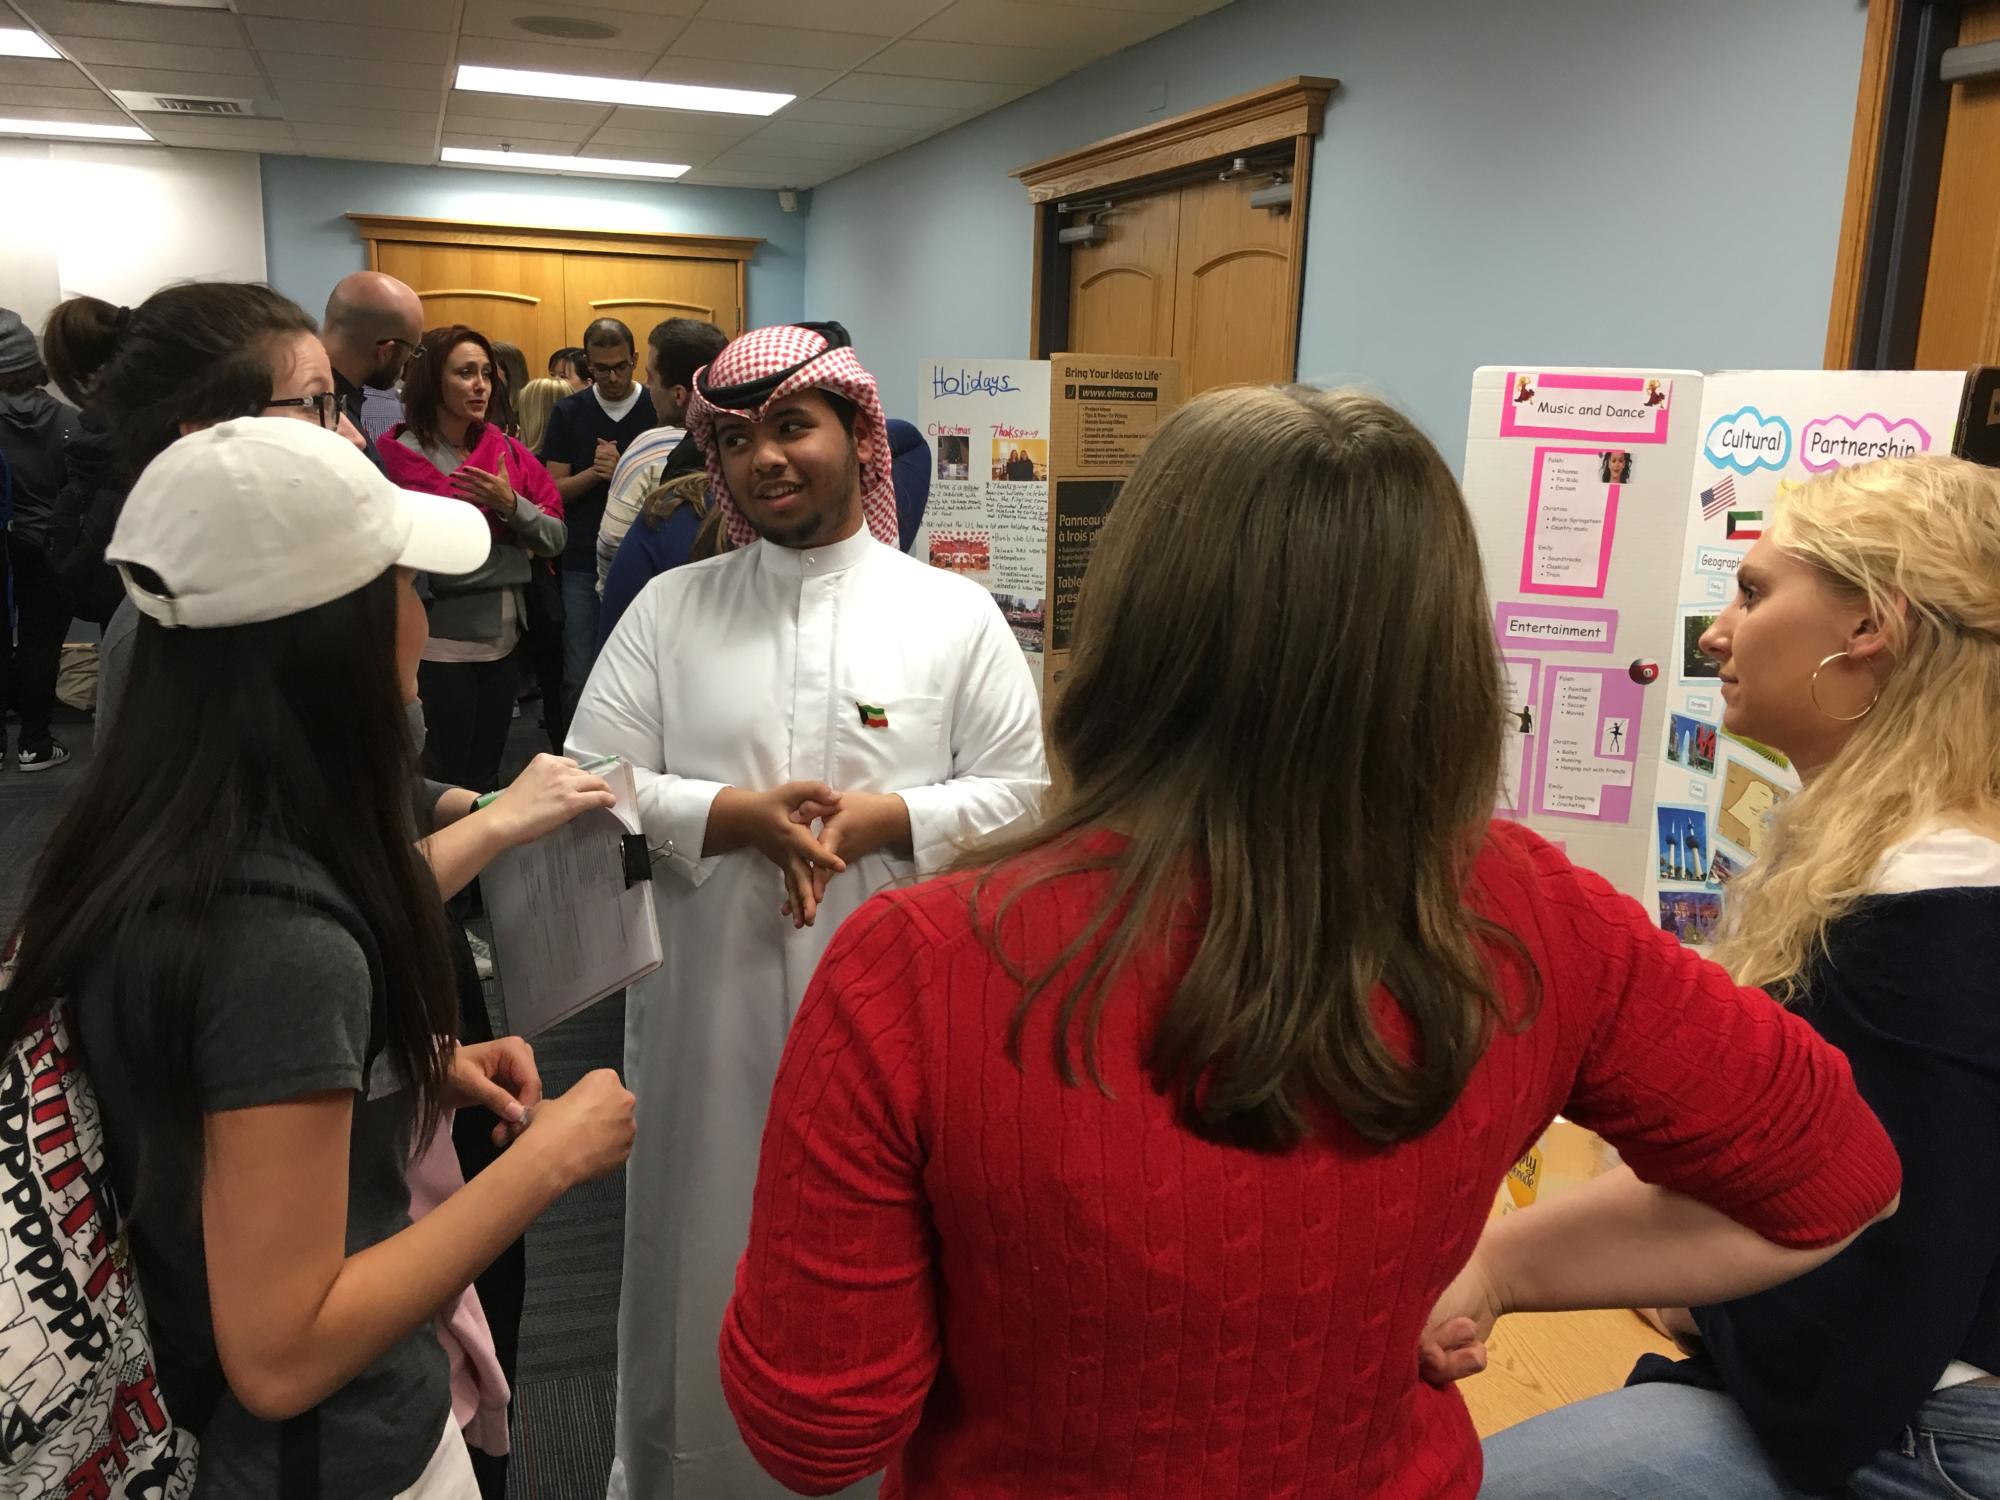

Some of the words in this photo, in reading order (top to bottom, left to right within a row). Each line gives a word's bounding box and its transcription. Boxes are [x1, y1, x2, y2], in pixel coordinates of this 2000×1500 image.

[932, 365, 1020, 398] Holidays
[1065, 367, 1088, 380] Bring
[1089, 368, 1109, 379] Your
[1111, 369, 1134, 380] Ideas
[1134, 370, 1142, 380] to
[1082, 388, 1154, 399] www.elmers.com
[1537, 402, 1574, 414] Music
[1578, 403, 1601, 416] and
[1606, 404, 1645, 418] Dance
[928, 420, 971, 436] Christmas
[1721, 429, 1782, 451] Cultural
[1810, 432, 1915, 459] Partnership
[1059, 514, 1100, 527] Panneau
[1059, 530, 1065, 542] à
[1066, 529, 1088, 542] trois
[1701, 553, 1742, 570] Geograph
[1057, 576, 1083, 588] Table
[1057, 592, 1080, 607] pres
[1510, 620, 1601, 638] Entertainment
